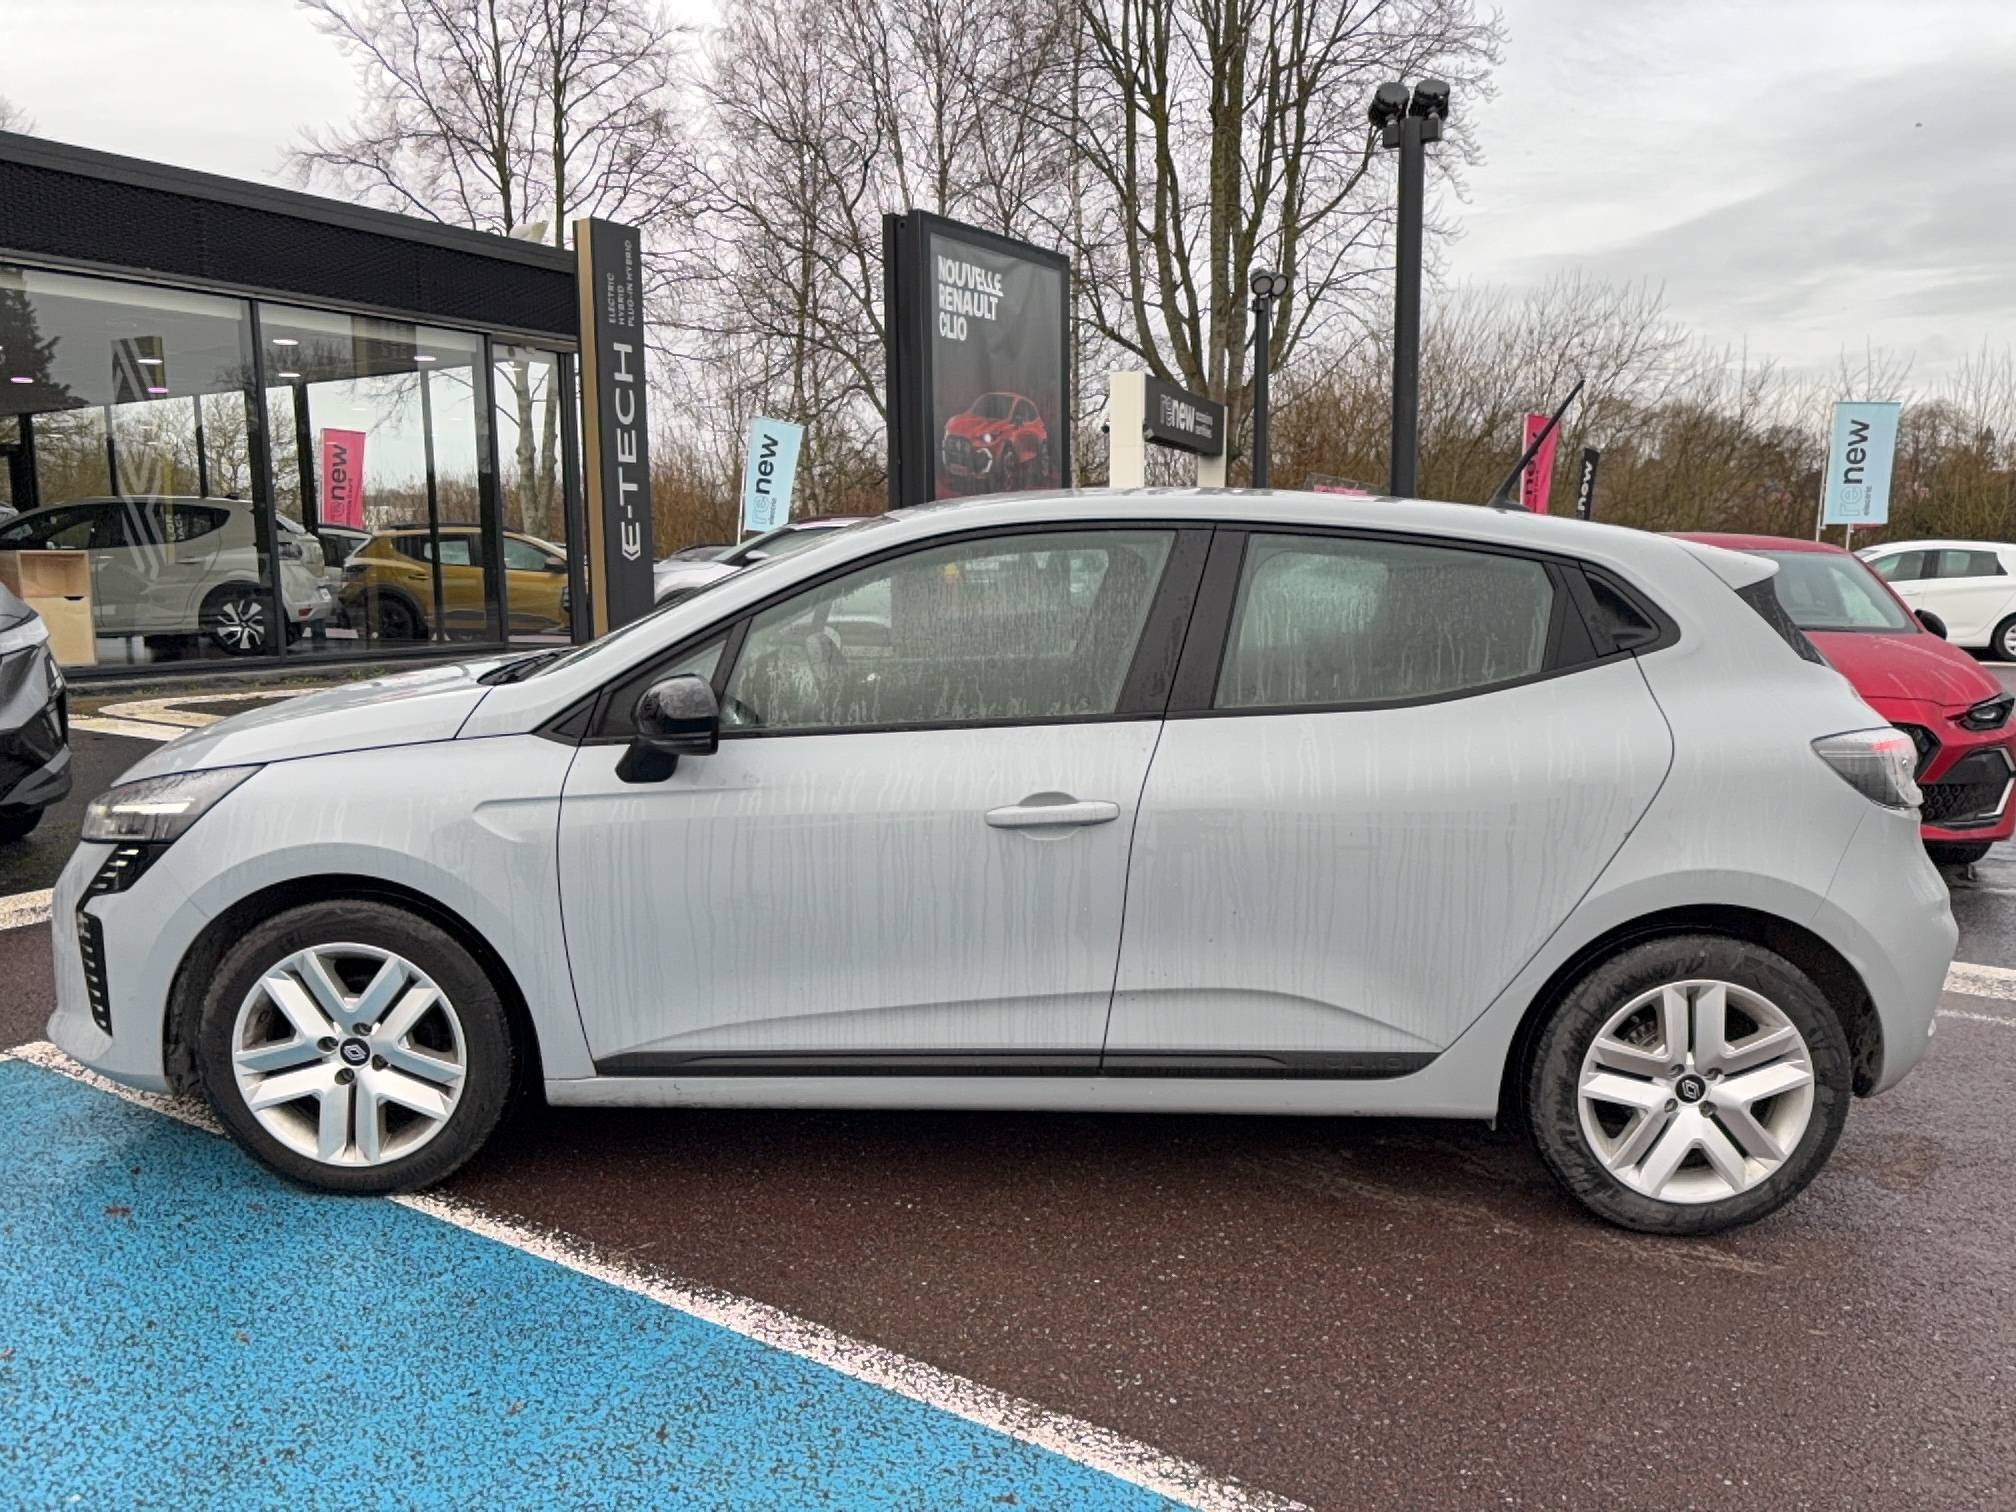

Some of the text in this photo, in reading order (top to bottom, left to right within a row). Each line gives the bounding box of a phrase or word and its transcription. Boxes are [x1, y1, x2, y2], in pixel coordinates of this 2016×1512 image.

[937, 255, 1004, 297] NOUVELLE
[606, 272, 617, 324] ELECTRIC
[617, 285, 625, 325] HYBRID
[938, 283, 998, 321] RENAULT
[939, 311, 967, 341] CLIO
[613, 341, 641, 561] E-TECH
